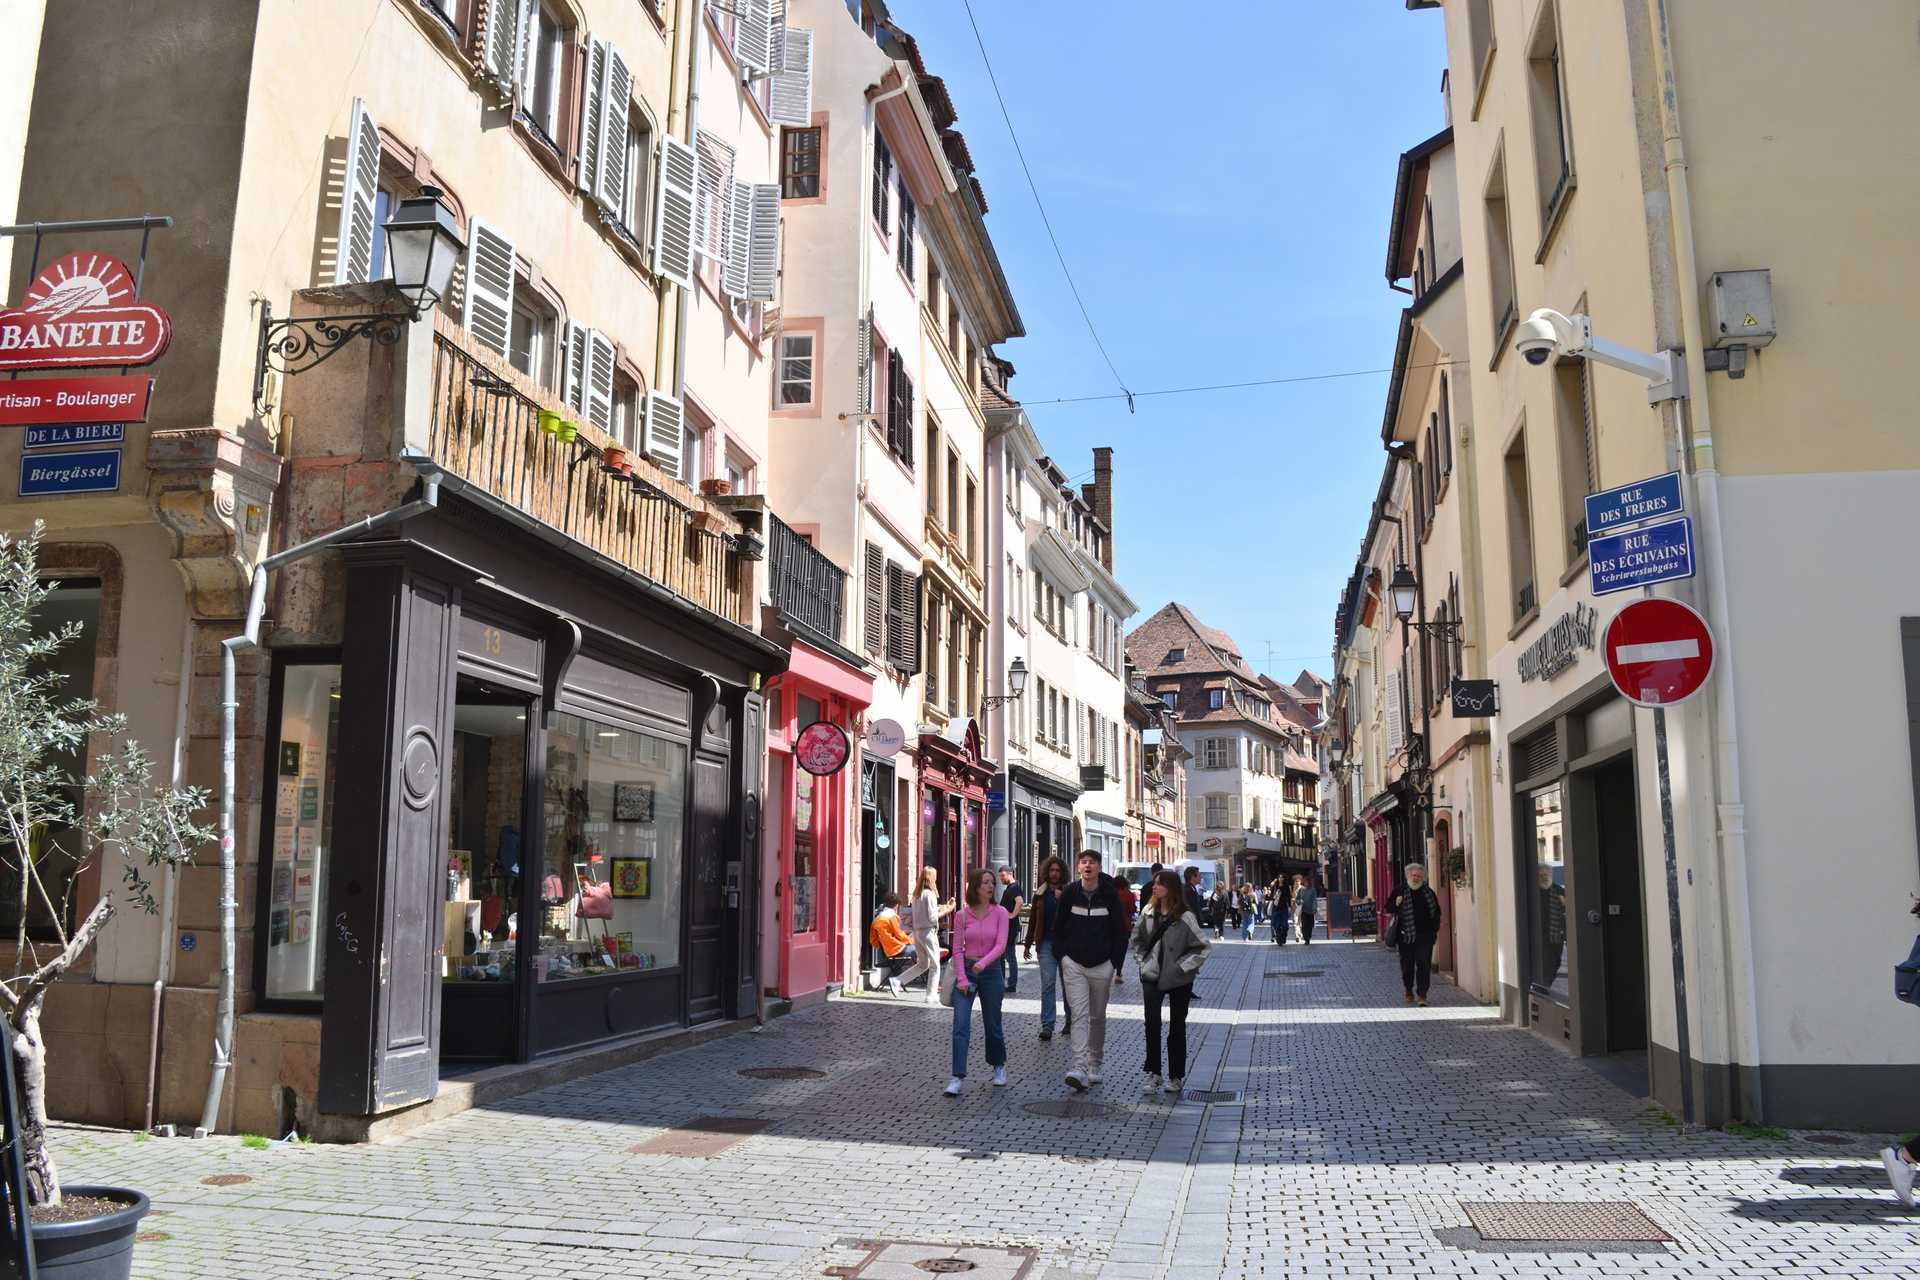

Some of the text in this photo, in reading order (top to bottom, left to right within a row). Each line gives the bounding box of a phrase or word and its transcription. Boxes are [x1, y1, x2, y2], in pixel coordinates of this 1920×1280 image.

[0, 321, 145, 349] BANETTE
[0, 393, 41, 408] rtisan
[56, 391, 136, 408] Boulanger
[29, 424, 121, 442] DE LA BIERE
[30, 464, 112, 483] Biergässel
[1620, 488, 1643, 504] RUE
[1600, 496, 1668, 523] DES FRERES
[1624, 534, 1650, 550] RUE
[1593, 543, 1686, 574] DES ECRIVAINS
[484, 627, 500, 656] 13
